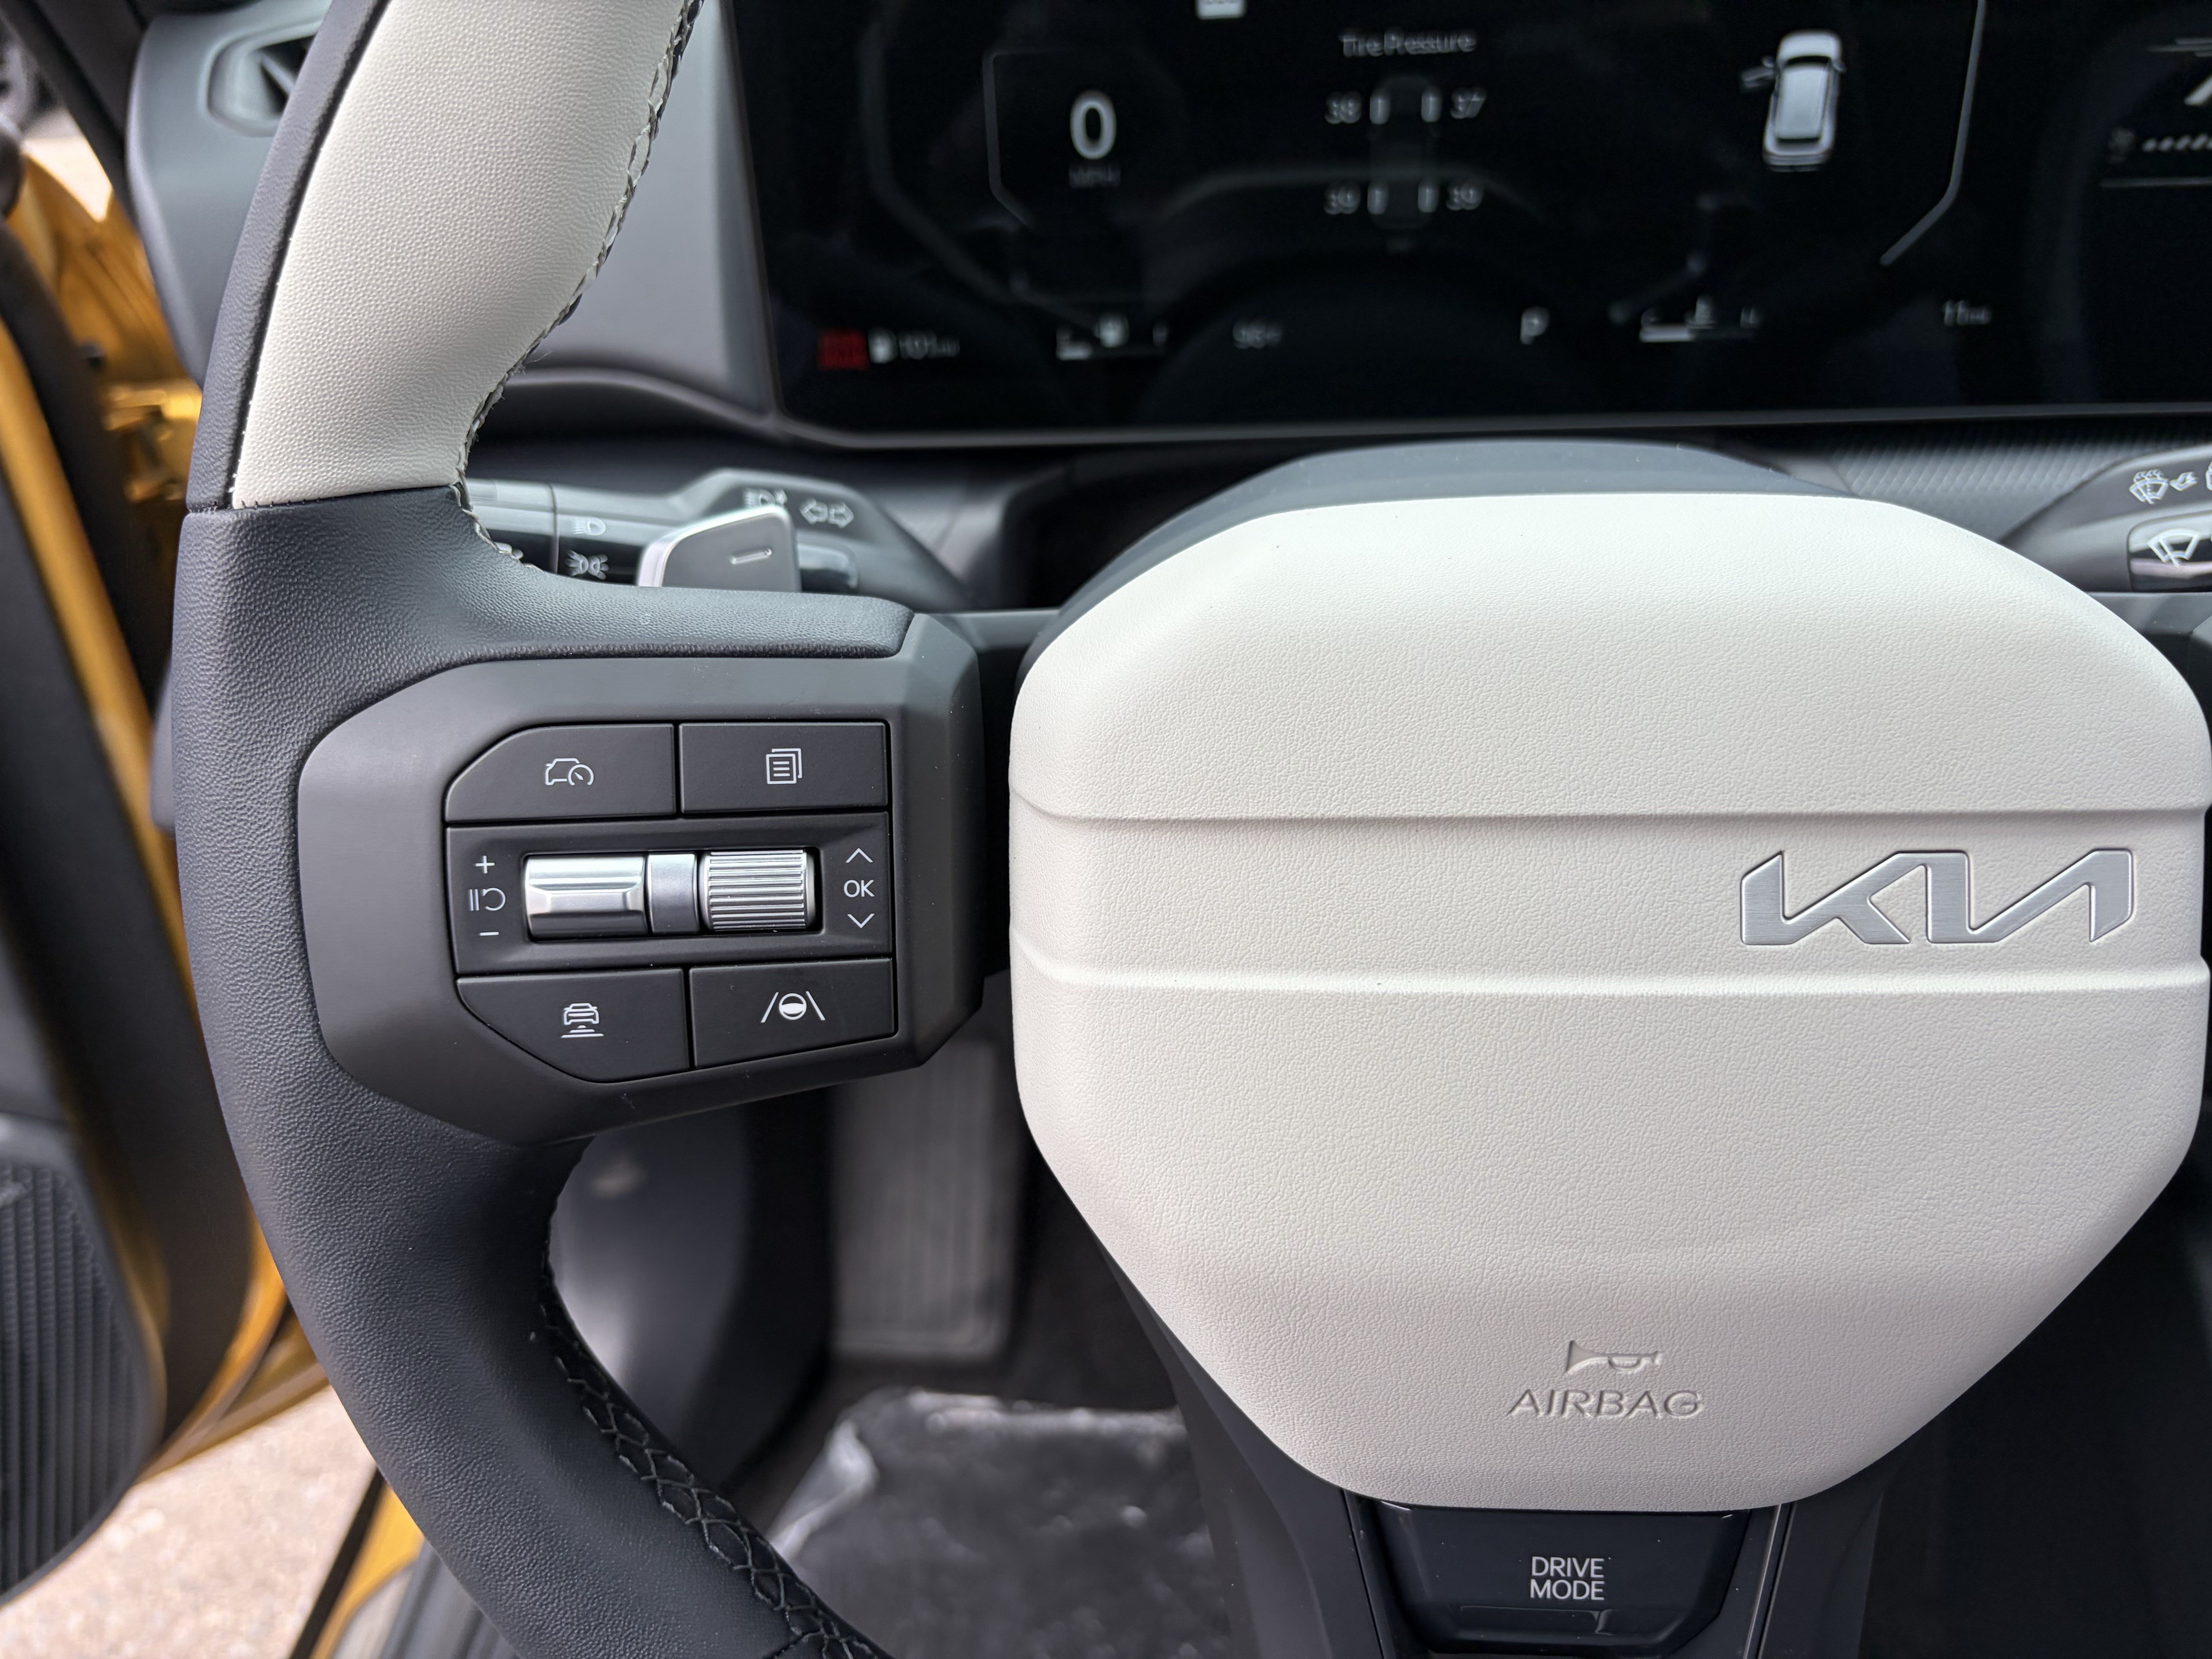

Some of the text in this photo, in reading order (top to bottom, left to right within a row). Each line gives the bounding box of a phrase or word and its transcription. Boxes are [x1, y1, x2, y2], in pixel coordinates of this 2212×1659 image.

[1338, 27, 1478, 57] Tire Pressure
[1450, 87, 1486, 119] 37
[1069, 89, 1117, 160] 0
[1520, 306, 1550, 345] P
[844, 879, 875, 897] OK
[1741, 850, 2135, 946] KIA
[1508, 1389, 1703, 1420] AIRBAG
[1532, 1556, 1604, 1578] DRIVE
[1530, 1579, 1605, 1601] MODE
